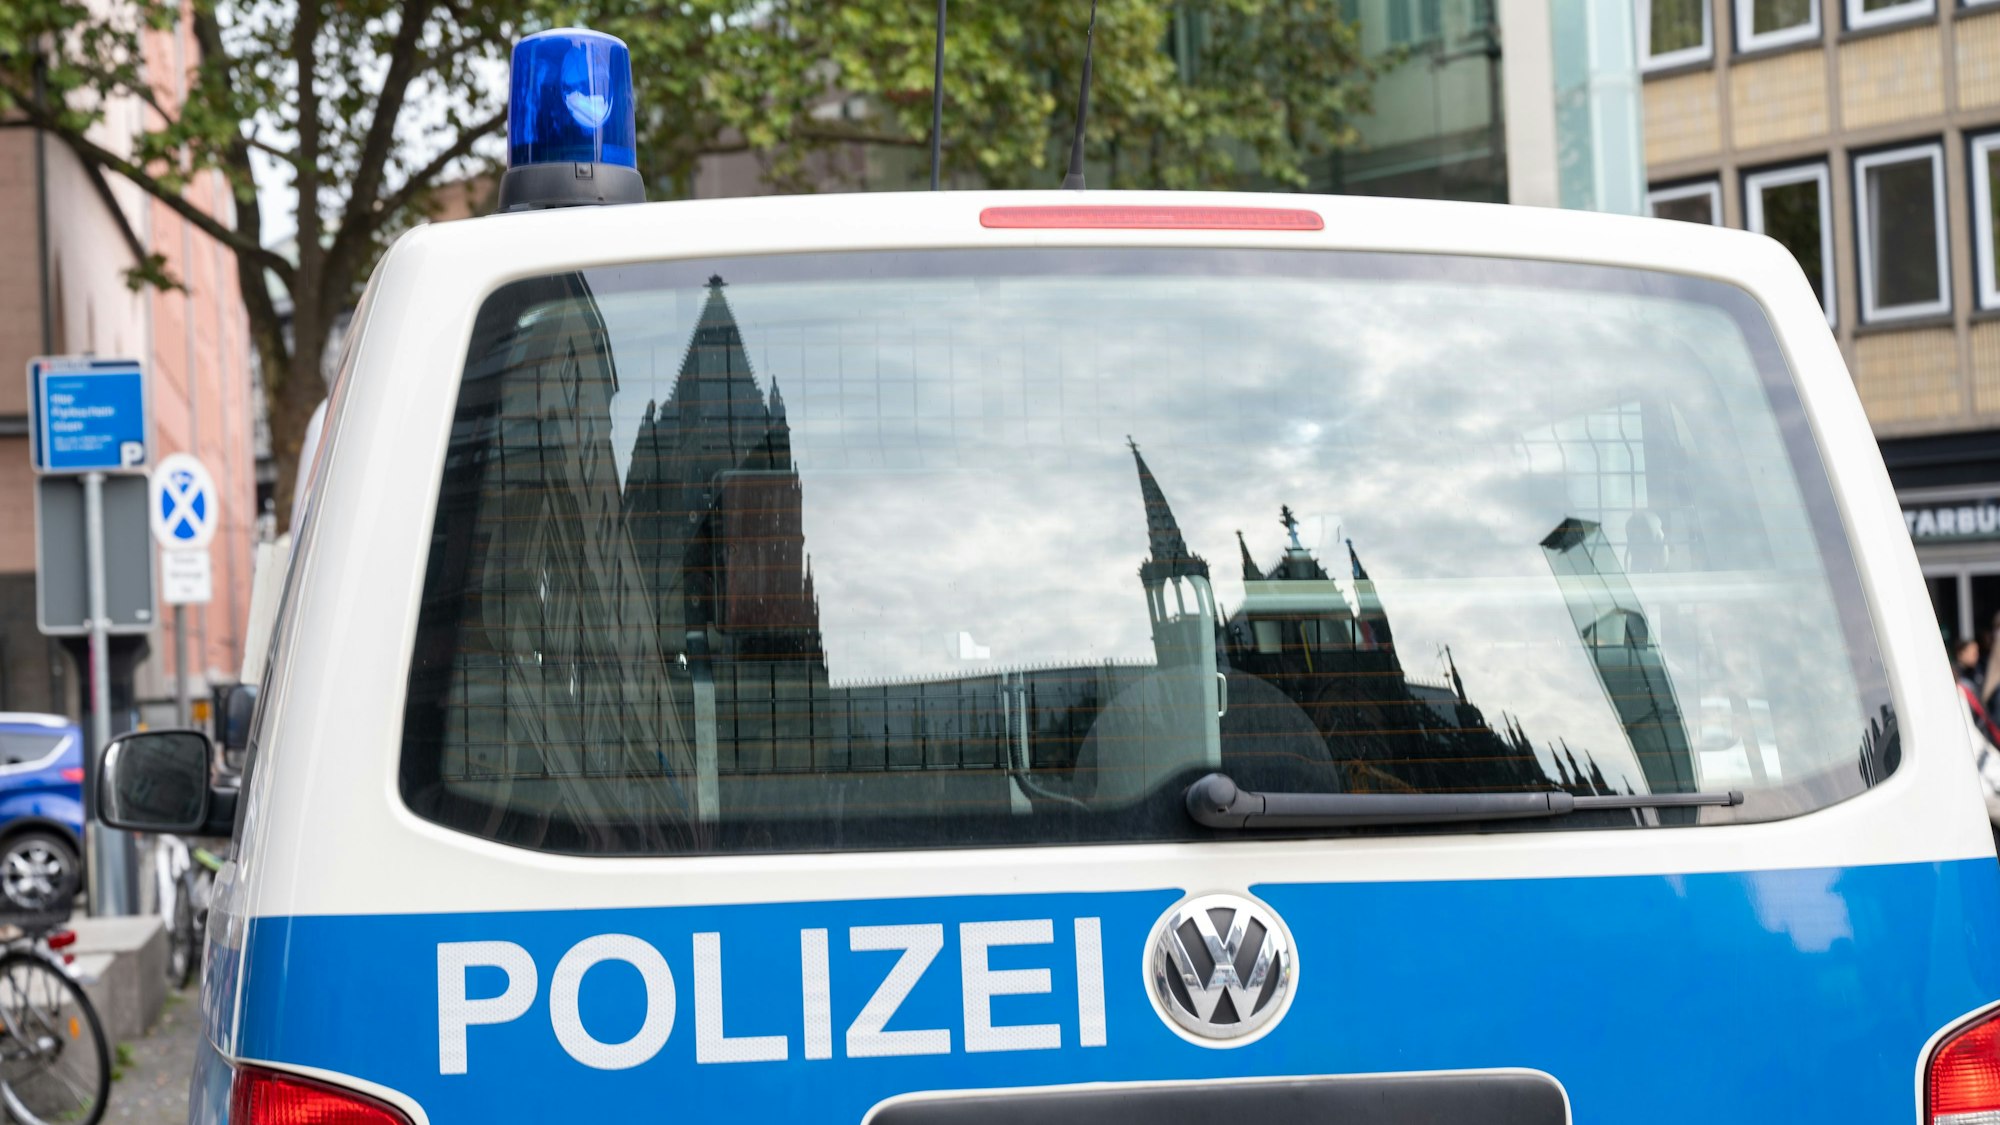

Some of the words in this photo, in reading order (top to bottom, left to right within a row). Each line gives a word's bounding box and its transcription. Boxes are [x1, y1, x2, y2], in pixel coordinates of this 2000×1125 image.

[120, 441, 144, 468] P
[1902, 504, 2000, 537] TARBU
[437, 917, 1107, 1074] POLIZEI
[1153, 894, 1290, 1039] VW
